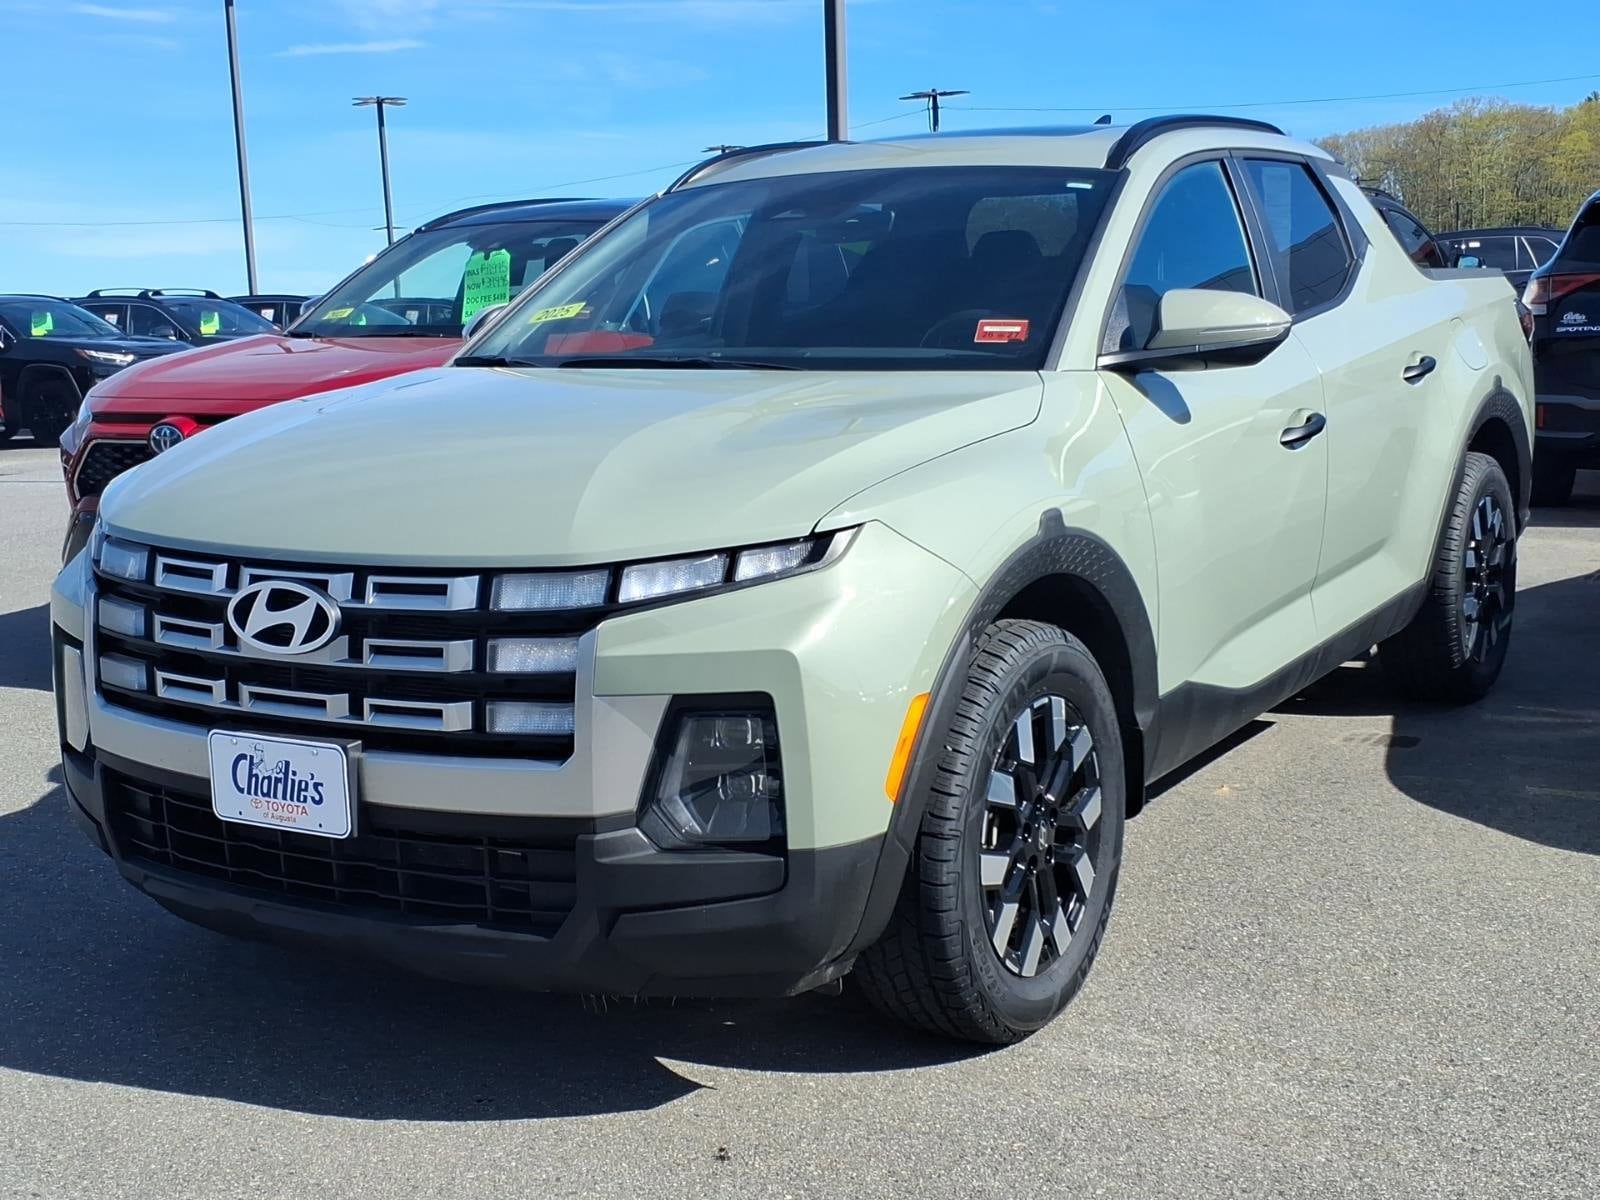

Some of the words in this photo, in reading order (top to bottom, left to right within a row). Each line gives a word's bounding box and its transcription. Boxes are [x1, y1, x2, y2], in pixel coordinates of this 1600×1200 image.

[466, 296, 479, 304] DOC
[480, 294, 492, 303] FEE
[536, 307, 572, 321] 2025
[231, 752, 324, 806] Charlie's
[264, 800, 308, 816] TOYOTA
[270, 812, 297, 823] Augusta
[1072, 900, 1111, 992] KELLY
